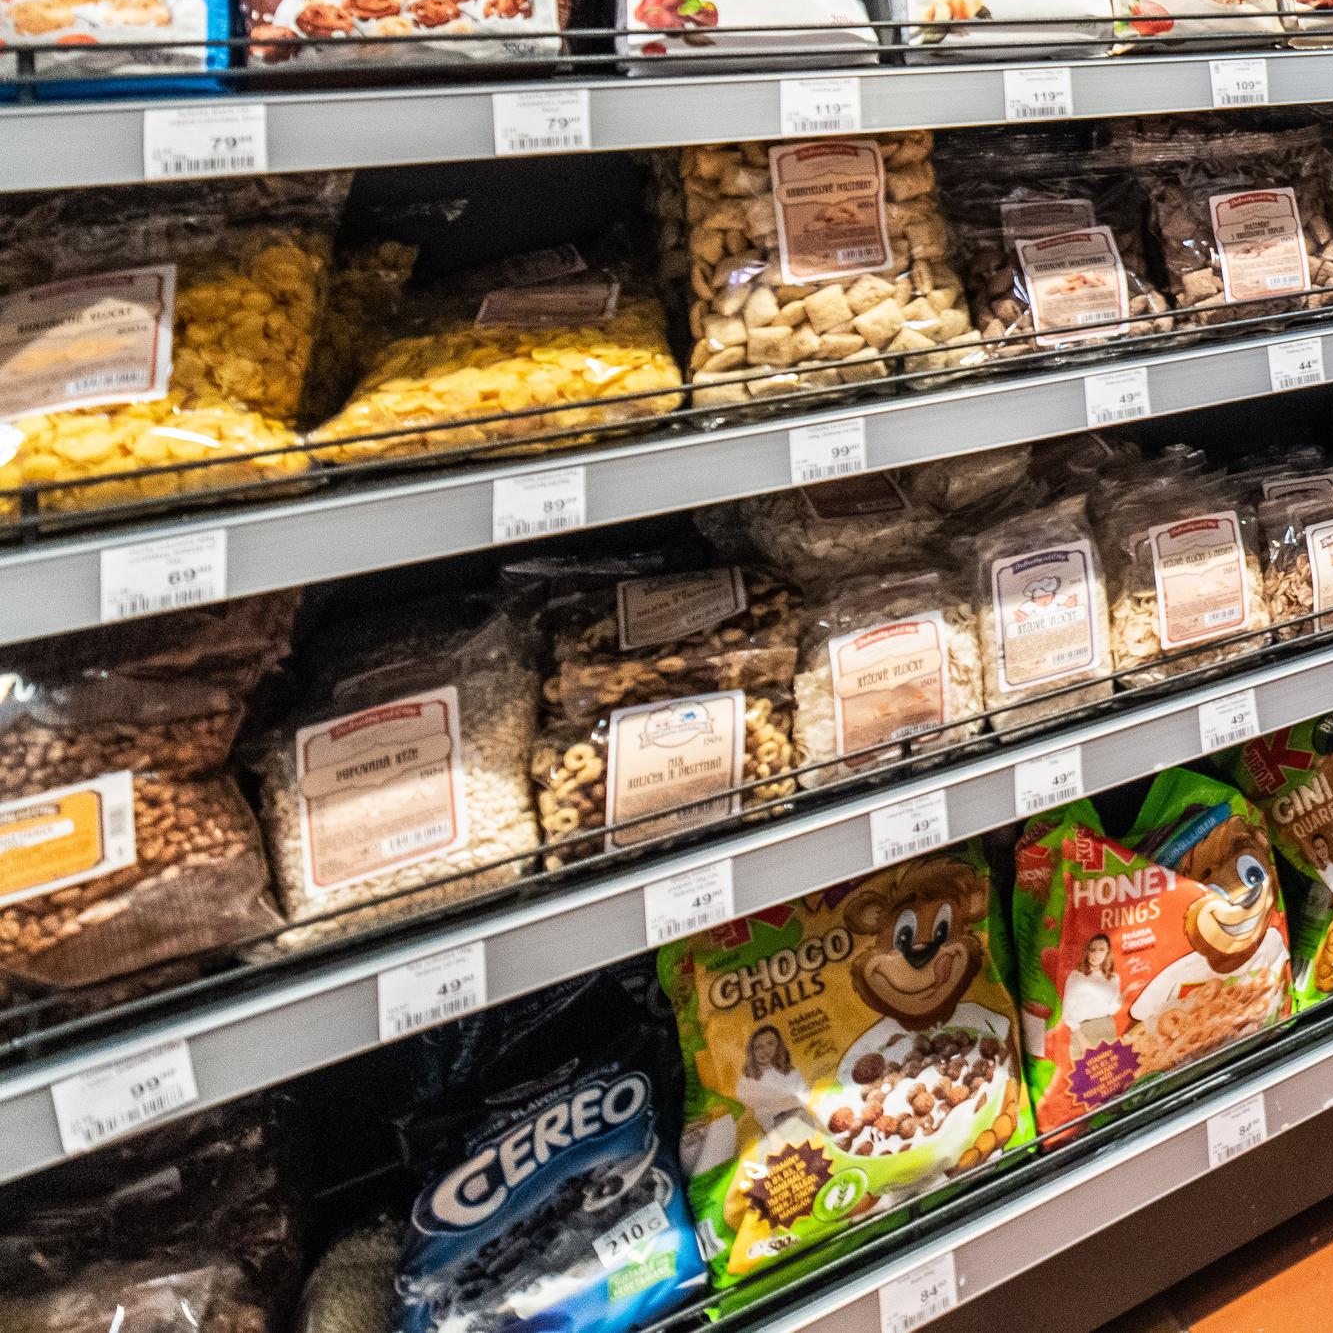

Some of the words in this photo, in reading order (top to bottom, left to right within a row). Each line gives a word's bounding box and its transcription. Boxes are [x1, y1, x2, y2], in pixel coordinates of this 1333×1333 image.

[1271, 777, 1333, 826] CINI
[1072, 865, 1178, 909] HONEY
[1100, 896, 1162, 930] RINGS
[707, 926, 854, 1011] CHOCO
[749, 971, 827, 1021] BALLS
[431, 1078, 647, 1227] CEREO
[606, 1224, 643, 1256] 210
